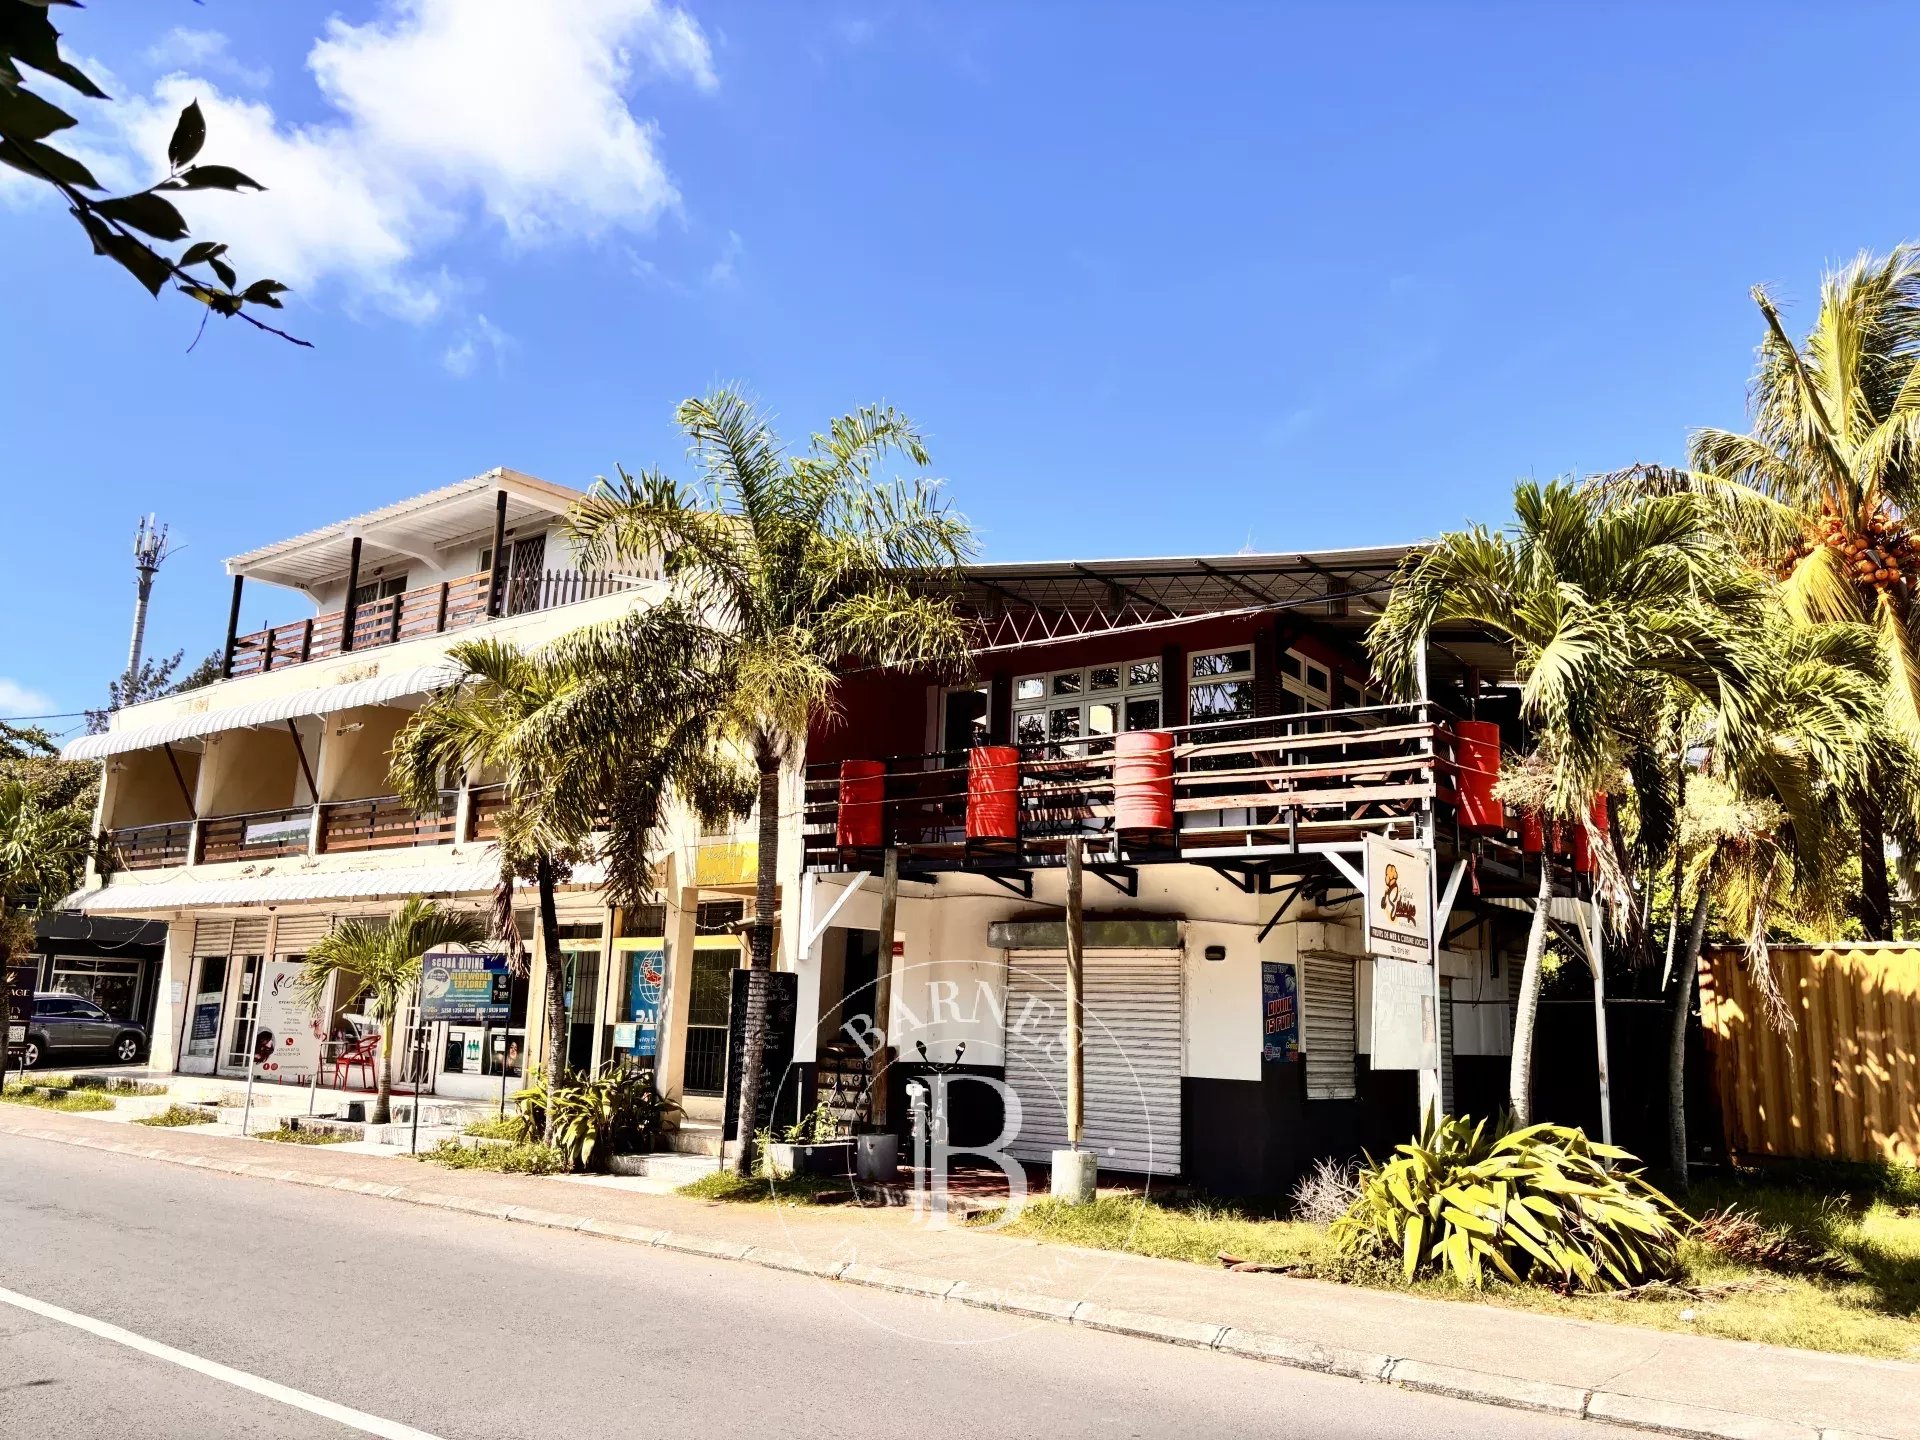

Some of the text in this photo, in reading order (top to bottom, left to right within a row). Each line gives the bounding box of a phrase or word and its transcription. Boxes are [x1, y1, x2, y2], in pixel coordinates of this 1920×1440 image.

[431, 956, 485, 969] SCUBA DIVING
[468, 972, 493, 981] WORLD
[454, 980, 488, 989] EXPLORER
